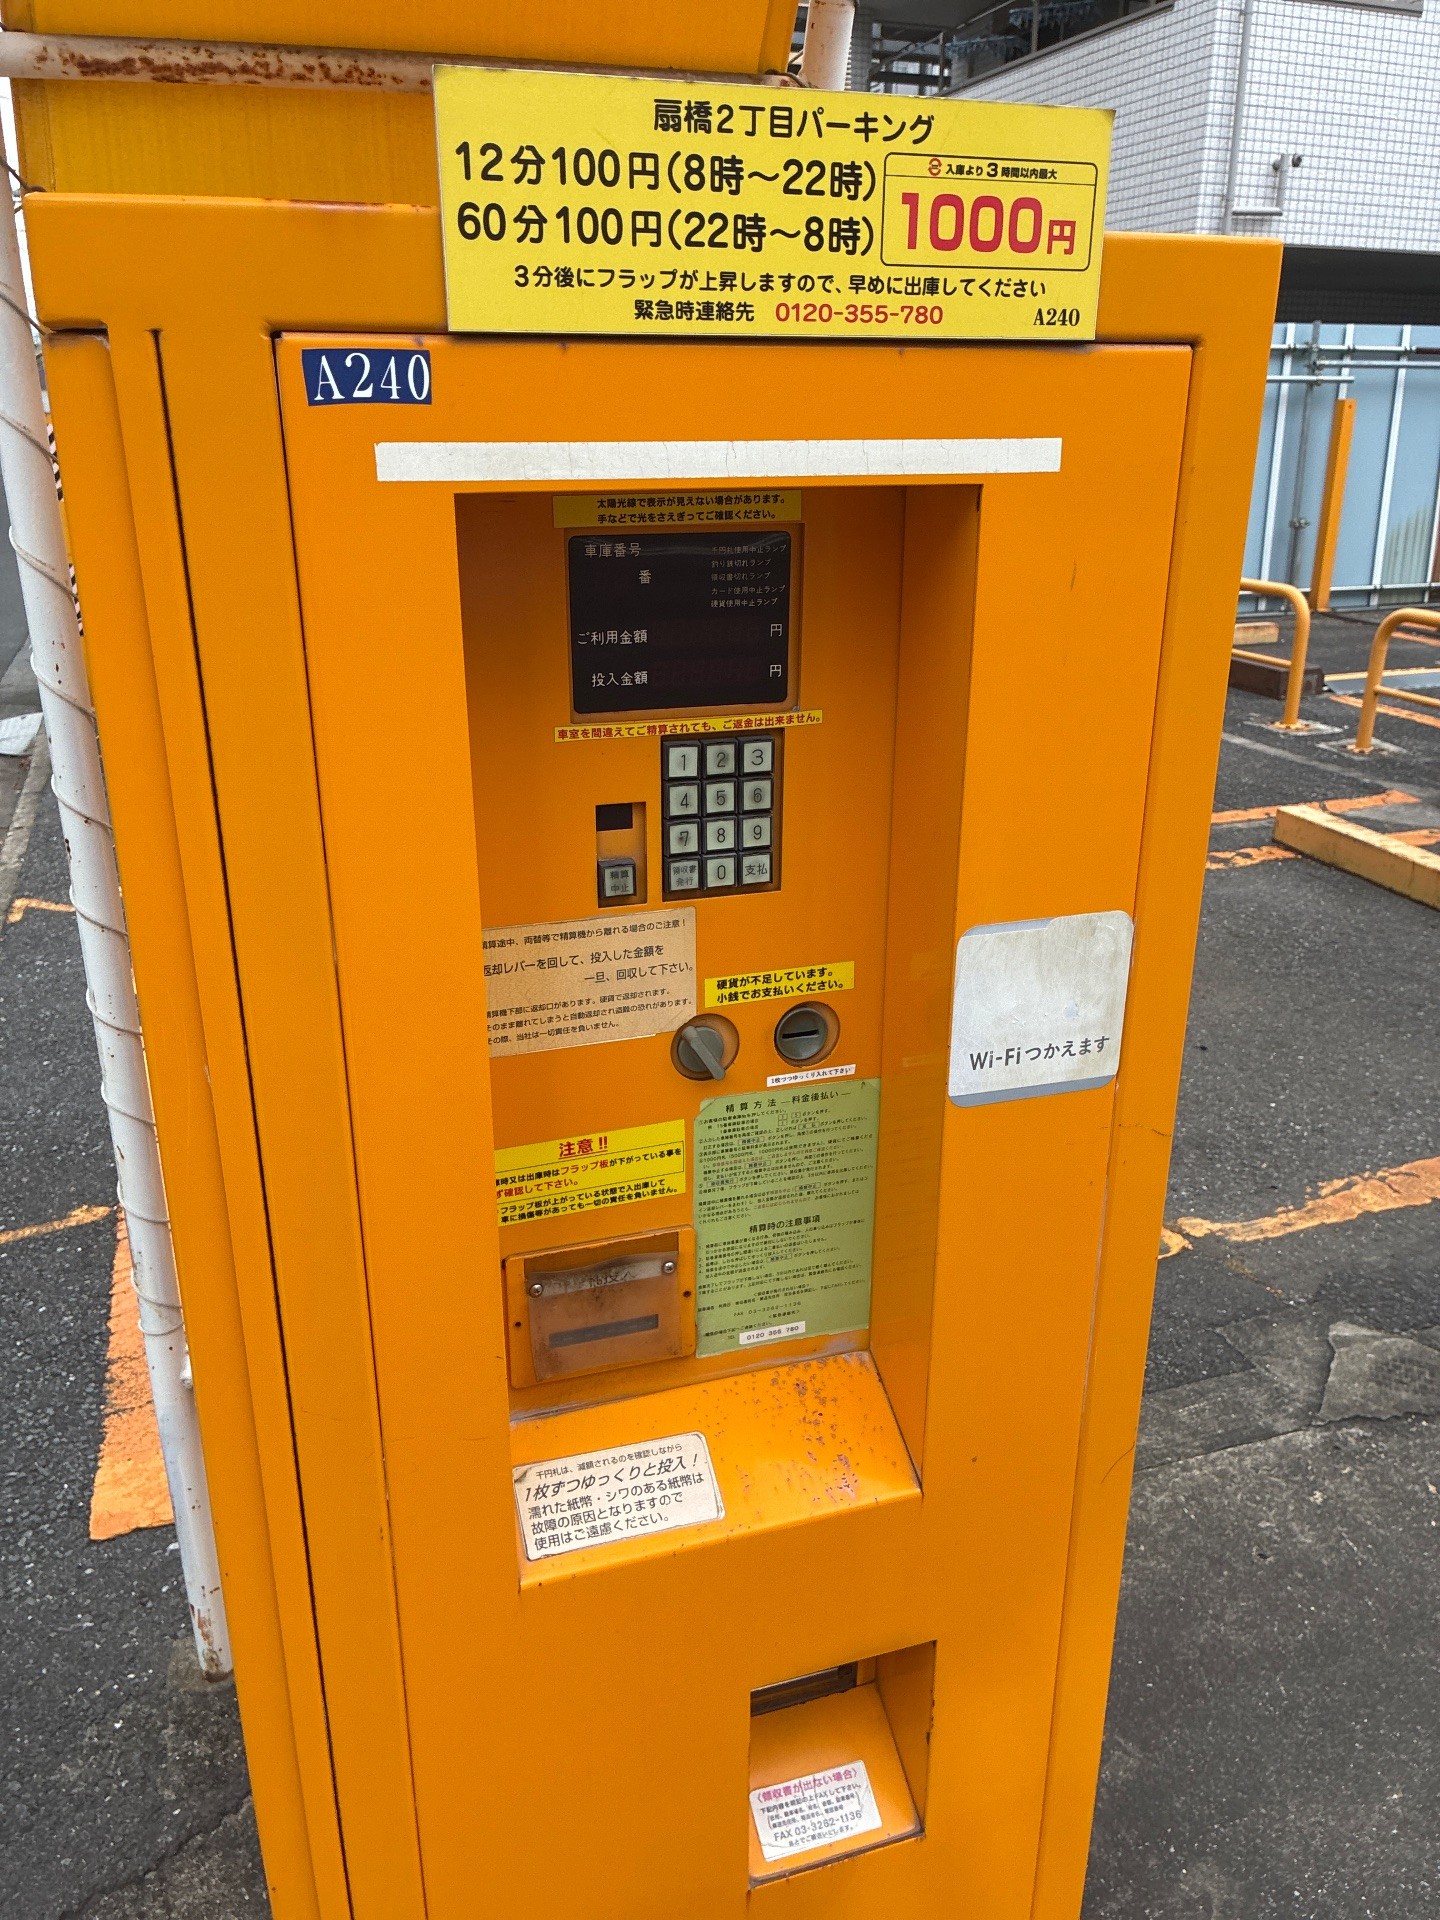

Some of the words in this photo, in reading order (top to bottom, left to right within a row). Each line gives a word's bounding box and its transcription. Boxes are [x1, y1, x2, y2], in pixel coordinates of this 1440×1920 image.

[653, 100, 935, 145] 扇橋2丁目パーキング
[901, 192, 1076, 255] 1000円
[513, 266, 1047, 298] 3分後にフラップが上昇しますので、早めに出庫してください
[634, 301, 755, 322] 緊急時連絡先
[775, 303, 943, 325] 0120-355-780
[1033, 307, 1081, 328] A240
[314, 352, 430, 400] A240
[597, 494, 785, 509] 太陽光線で表示が見えない場合があります。
[597, 509, 776, 524] 手などで光をさえぎってご確認ください。
[584, 543, 642, 558] 車庫番号
[638, 569, 652, 584] 番
[577, 629, 648, 647] ご利用金額
[770, 623, 783, 637] 円
[591, 671, 648, 688] 投入金額
[769, 664, 782, 677] 円
[557, 714, 821, 740] 車室を間違えてご精算されても、ご返金は出来ません。
[717, 752, 726, 768] 2
[752, 749, 764, 766] 3
[680, 792, 689, 808] 4
[716, 790, 726, 806] 5
[753, 788, 762, 804] 6
[679, 830, 689, 847] 7
[717, 828, 726, 843] 8
[753, 825, 762, 840] 9
[745, 862, 768, 877] 支払
[584, 961, 693, 984] 一旦、回収して下さい。
[717, 967, 833, 991] 硬貨が不足しています。
[717, 979, 844, 1004] 小銭でお支払いください。
[749, 1214, 821, 1234] 精算時の注意事項
[746, 1331, 765, 1341] 0120
[535, 1443, 683, 1480] 千円札は、減額されるのを確認しながら
[528, 1472, 704, 1520] 濡れた紙幣・シワのある紙幣は
[531, 1492, 683, 1536] 故障の原因となりますので
[534, 1512, 669, 1551] 使用はご遠慮ください。
[774, 1828, 793, 1842] FAX
